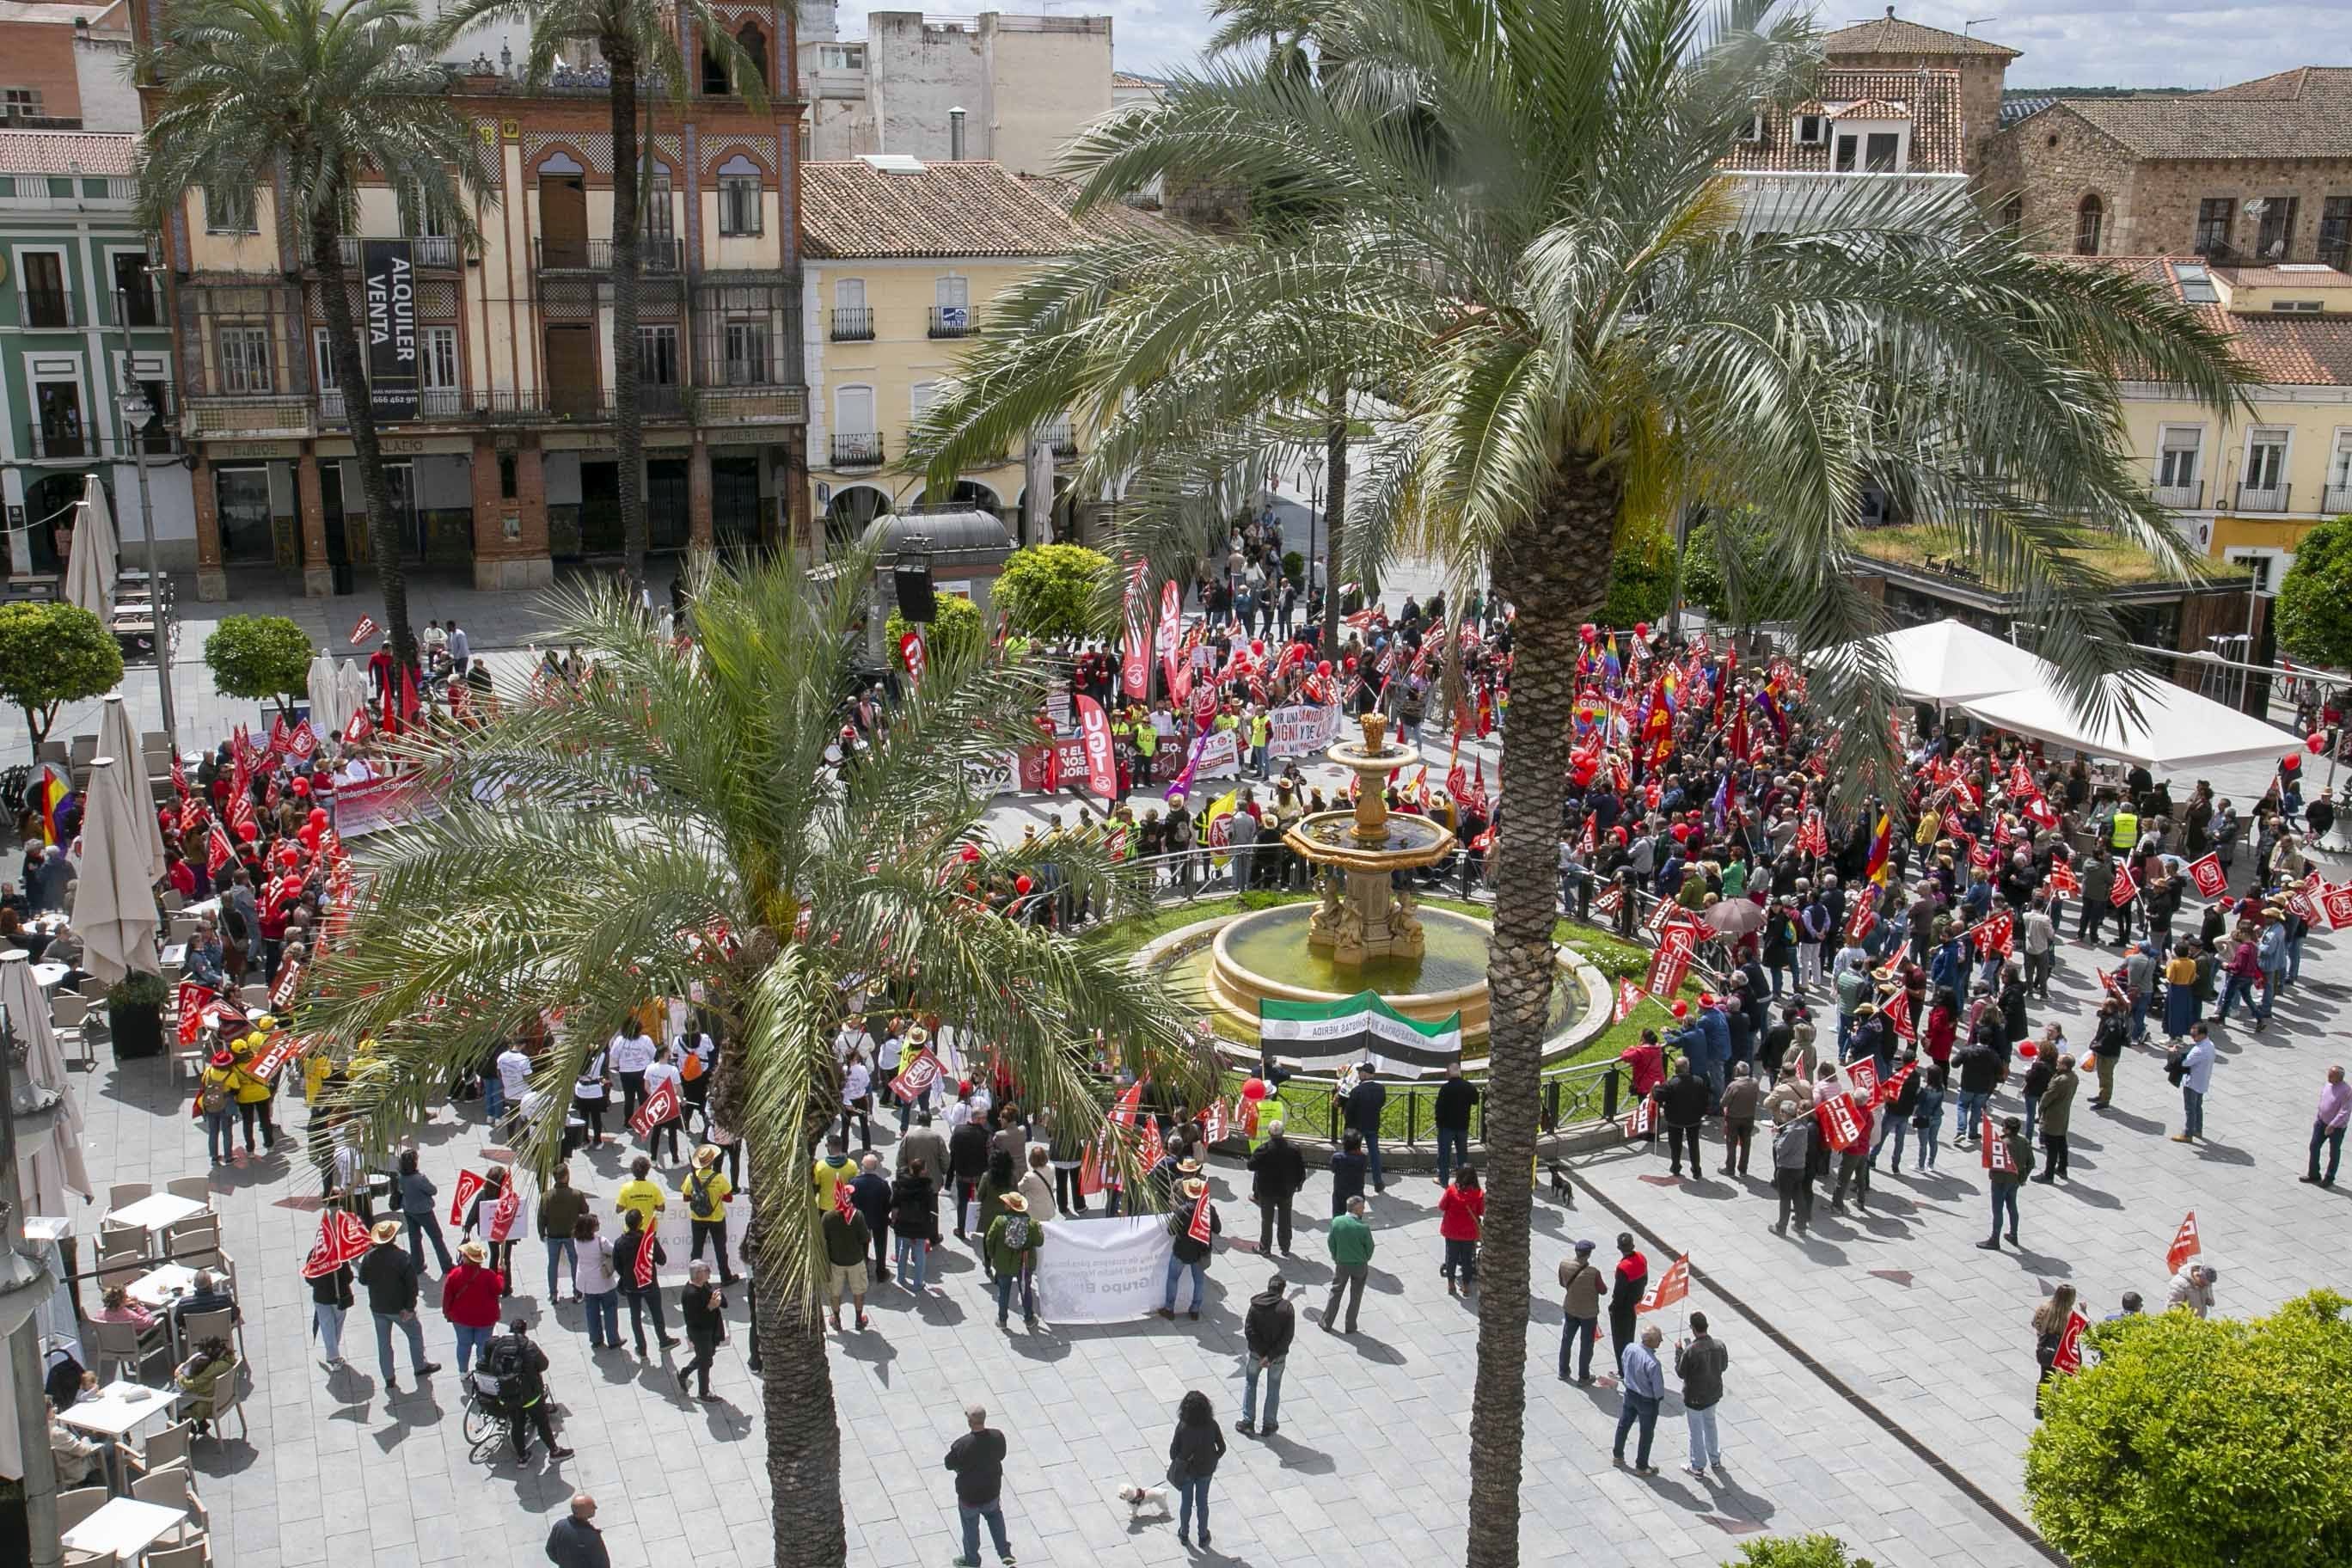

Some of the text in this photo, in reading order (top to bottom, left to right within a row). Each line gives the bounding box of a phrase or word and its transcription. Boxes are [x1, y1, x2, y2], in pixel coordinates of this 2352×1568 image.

[367, 274, 389, 345] VENTA
[391, 257, 415, 362] ALQUILER
[389, 395, 404, 404] 462
[1579, 699, 1607, 710] CON
[1043, 745, 1086, 757] PR EL
[1084, 709, 1107, 773] UGT
[1140, 732, 1156, 743] UGT
[1651, 952, 1672, 995] CCOO
[1830, 1096, 1860, 1142] CCOO
